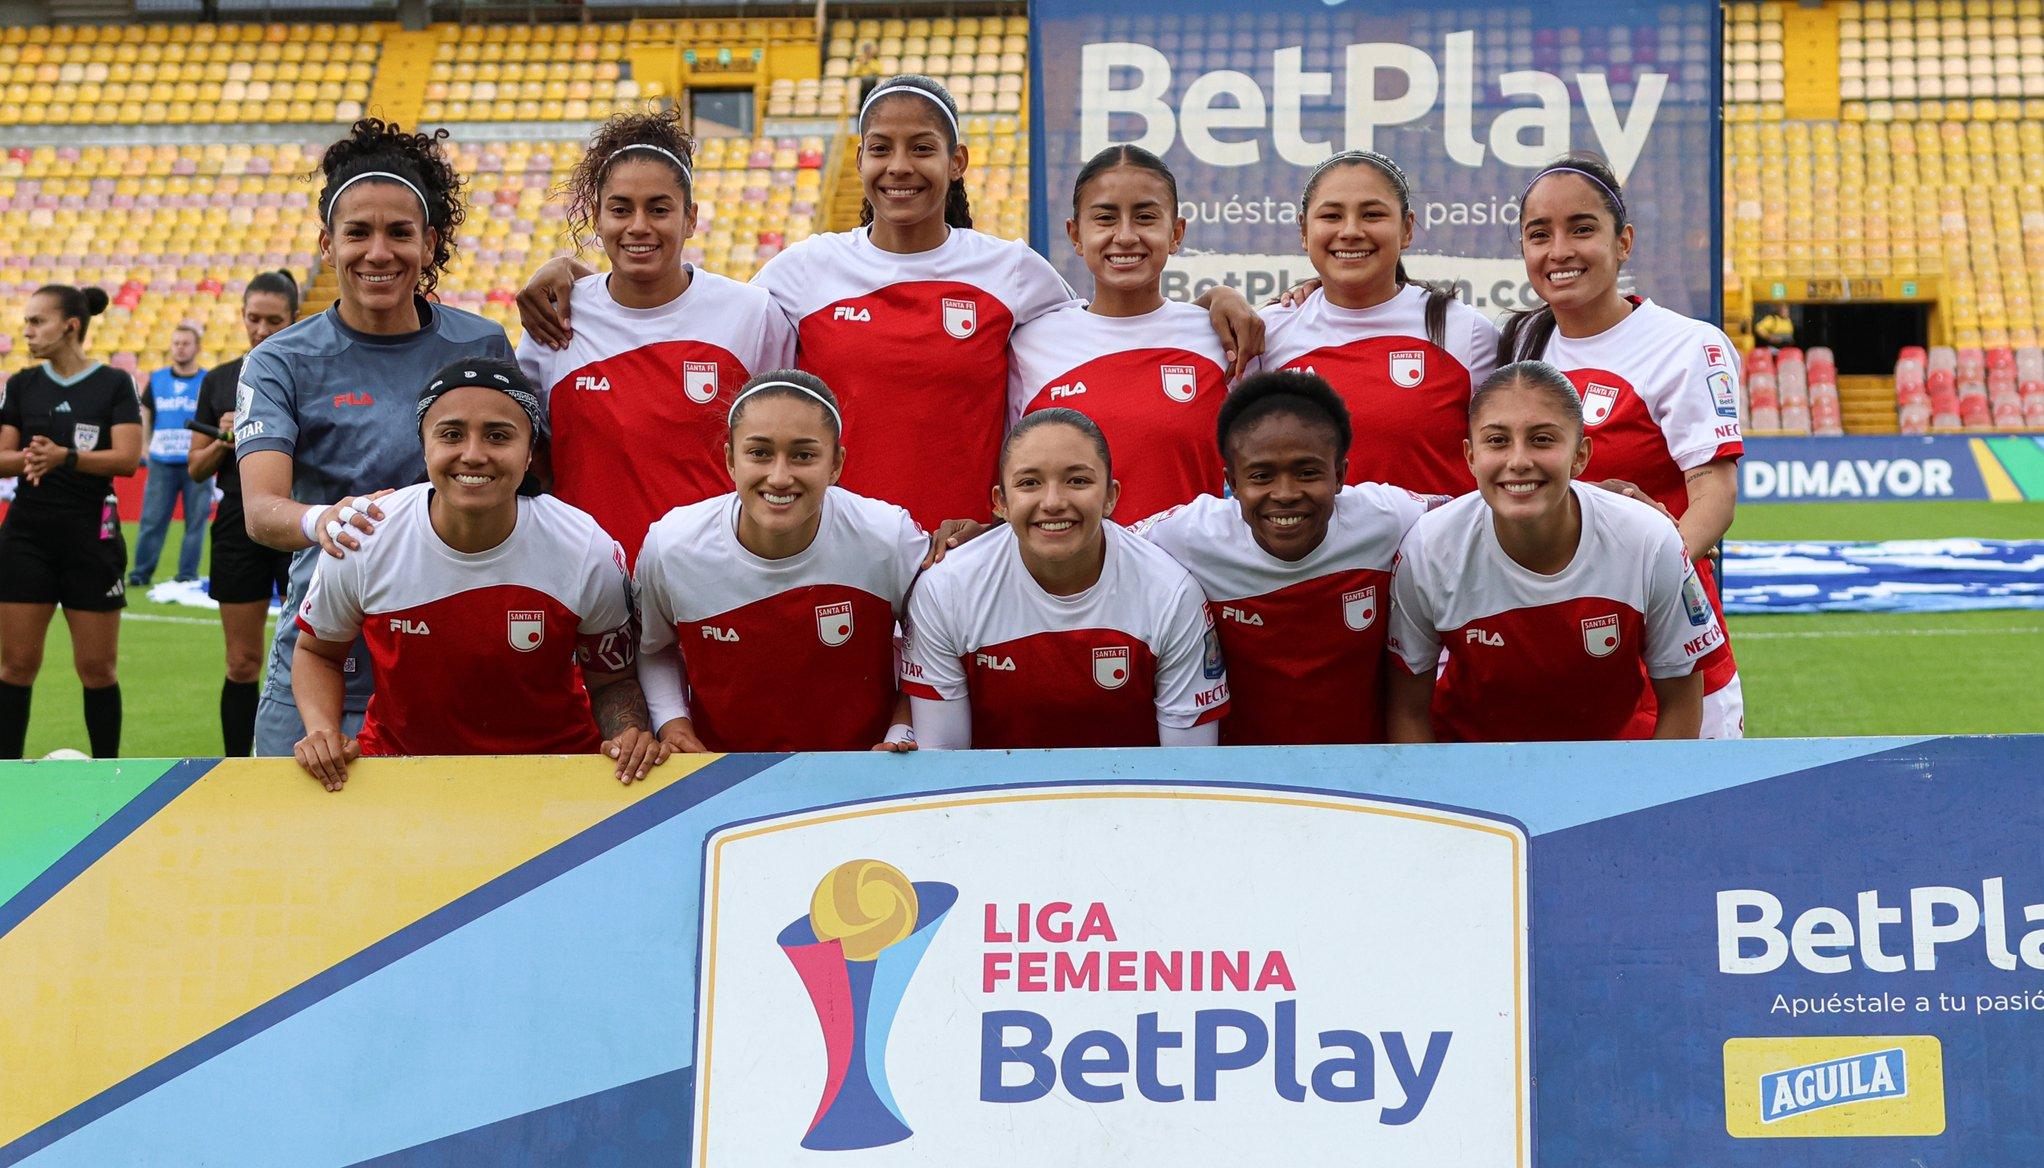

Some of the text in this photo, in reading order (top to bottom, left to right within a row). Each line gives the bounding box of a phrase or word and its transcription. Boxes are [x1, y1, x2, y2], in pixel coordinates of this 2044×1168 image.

[1080, 30, 1669, 189] BetPlay
[1178, 193, 1521, 231] puésta pasió
[945, 300, 965, 308] SANTA
[833, 306, 871, 322] FILA
[686, 363, 715, 372] SANTA FE
[1164, 367, 1184, 375] SANTA
[575, 376, 611, 391] FILA
[1050, 381, 1087, 401] FILA
[1589, 385, 1616, 398] SANTA FE
[333, 391, 374, 409] FILA
[235, 420, 264, 441] CTAR
[1714, 423, 1741, 439] NEC
[1743, 458, 1955, 499] DIMAYOR
[1344, 588, 1374, 602] SANTA FE
[510, 613, 542, 621] SANTA FE
[818, 604, 850, 617] SANTA FE
[1222, 605, 1264, 627] FILA
[390, 618, 431, 635] FILA
[1585, 617, 1616, 630] SANTA FE
[701, 625, 740, 642] FILA
[1466, 628, 1505, 647] FILA
[1683, 623, 1721, 657] NECTA
[976, 652, 1017, 672] FILA
[1095, 648, 1127, 659] SANTA FE
[902, 660, 924, 679] TAR
[1194, 682, 1229, 708] NECT
[983, 901, 1117, 943] LIGA
[1716, 876, 2044, 976] BetPla
[981, 949, 1297, 993] FEMENINA
[1770, 990, 2044, 1017] Apuéstale a tu pasió
[979, 999, 1454, 1126] BetPlay
[1770, 1055, 1897, 1116] AGUILA
